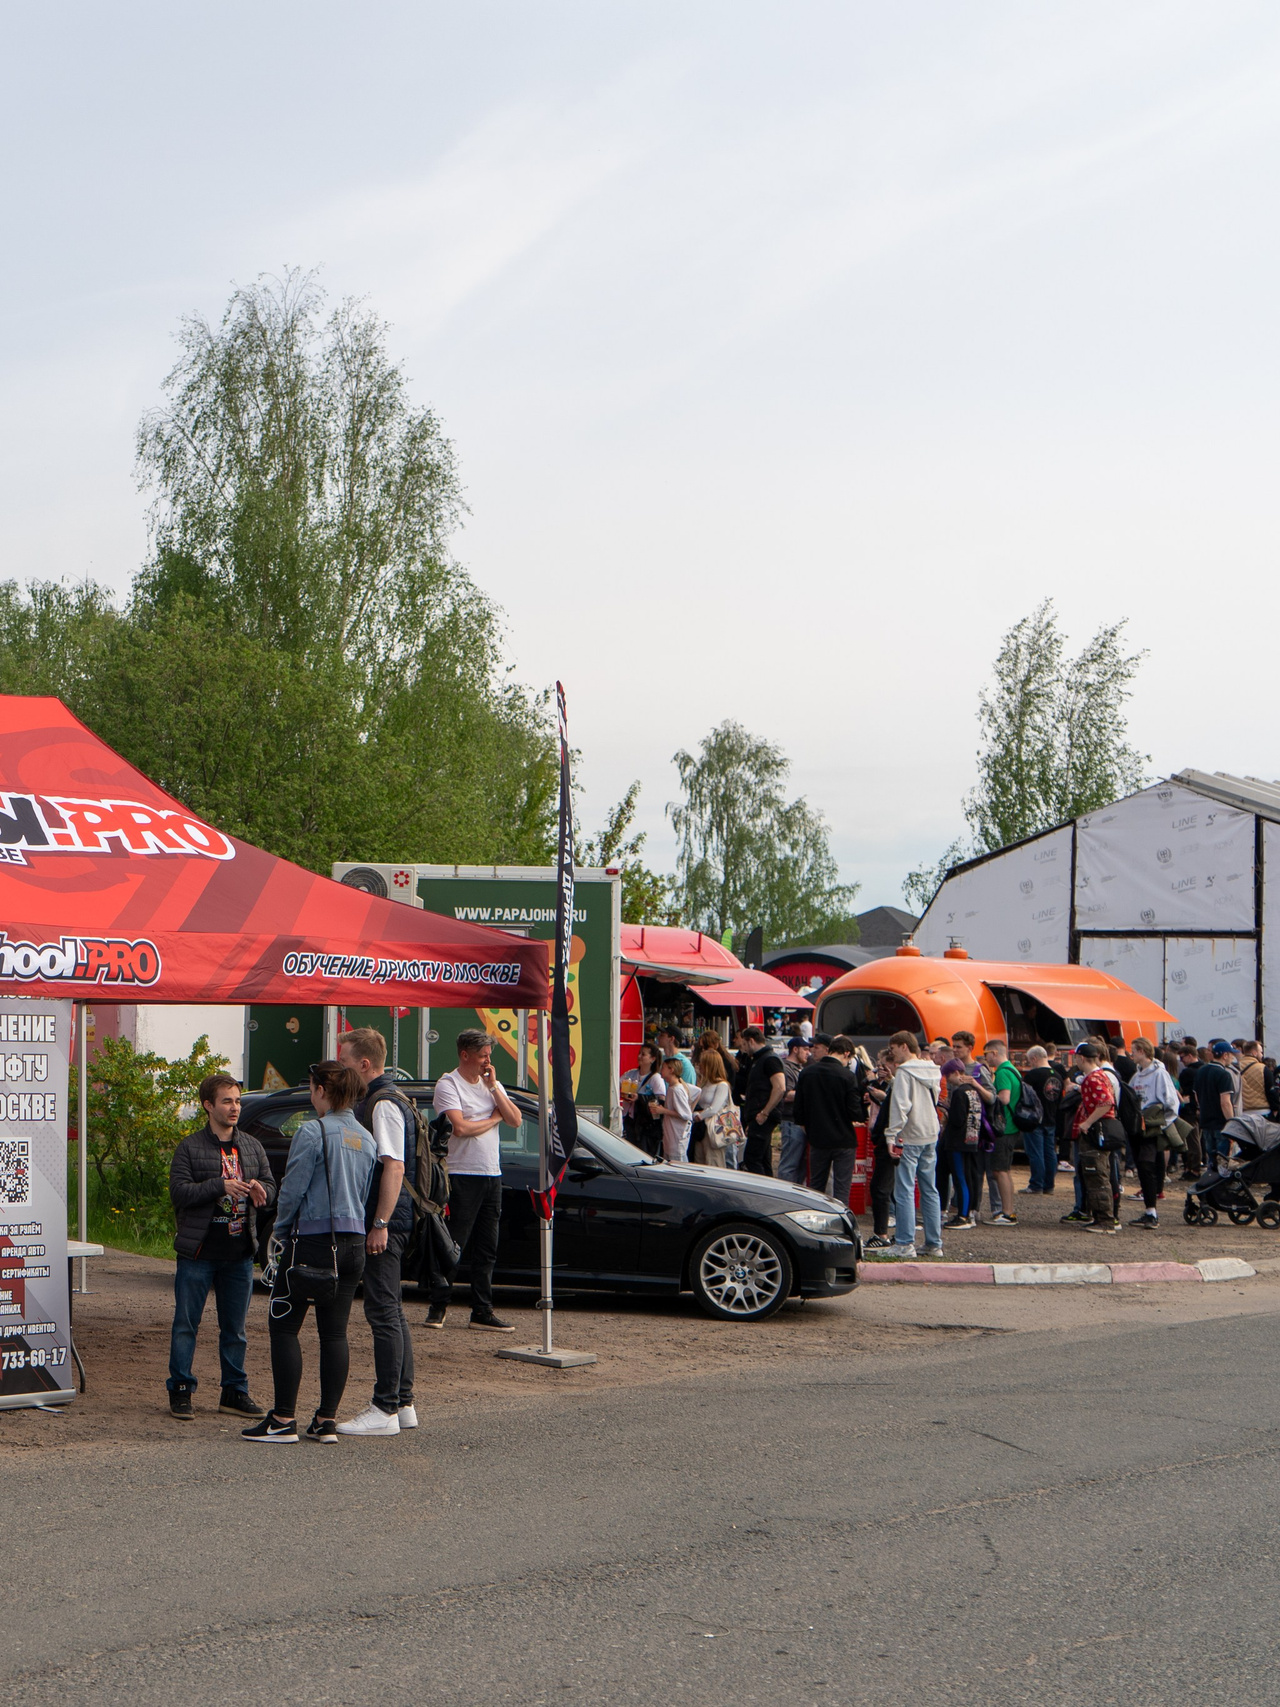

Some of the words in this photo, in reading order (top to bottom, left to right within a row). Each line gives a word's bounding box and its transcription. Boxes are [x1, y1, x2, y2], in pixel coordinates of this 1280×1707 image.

[1172, 815, 1197, 829] LINE
[1171, 876, 1197, 890] LINE
[454, 907, 587, 922] WWW.PAPAJOHNRU
[283, 952, 375, 979] ОБУЧЕНИЕ
[371, 958, 442, 985] ДРИФТУ
[441, 963, 455, 982] В
[453, 963, 521, 985] МОСКВЕ
[1215, 958, 1242, 972] LINE
[1211, 1004, 1239, 1018] LINE
[10, 1224, 19, 1236] ЗА
[19, 1221, 42, 1236] РУЛЁМ
[1, 1246, 27, 1259] АРЕНДА
[27, 1244, 45, 1256] АВТО
[2, 1266, 50, 1279] СЕРТИФИКАТЫ
[3, 1324, 26, 1338] ДРИФТ
[27, 1322, 56, 1335] ИВЕНТОВ
[1, 1346, 67, 1370] 733-60-17
